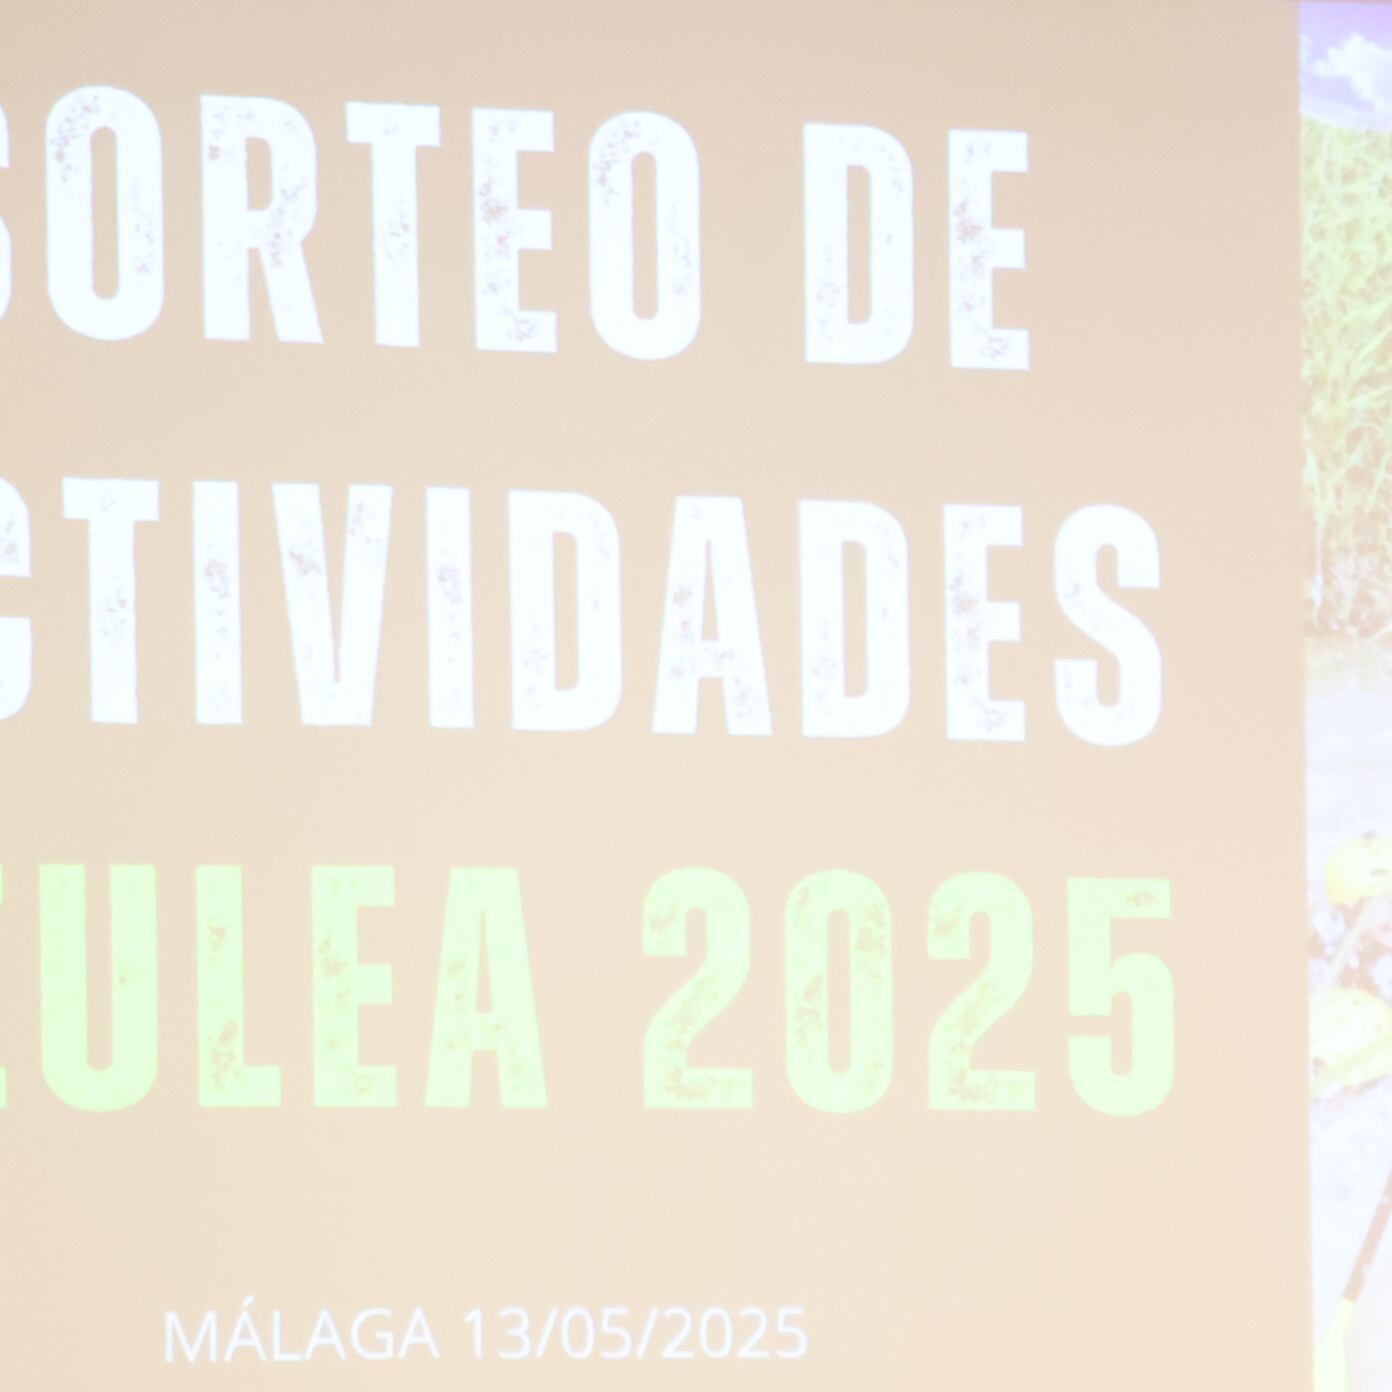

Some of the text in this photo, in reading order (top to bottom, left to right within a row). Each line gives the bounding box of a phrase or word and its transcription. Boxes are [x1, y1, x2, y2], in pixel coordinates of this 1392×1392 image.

[803, 122, 1030, 371] DE
[641, 866, 1176, 1118] 2025
[162, 1295, 809, 1364] MÁLAGA 13/05/2025
